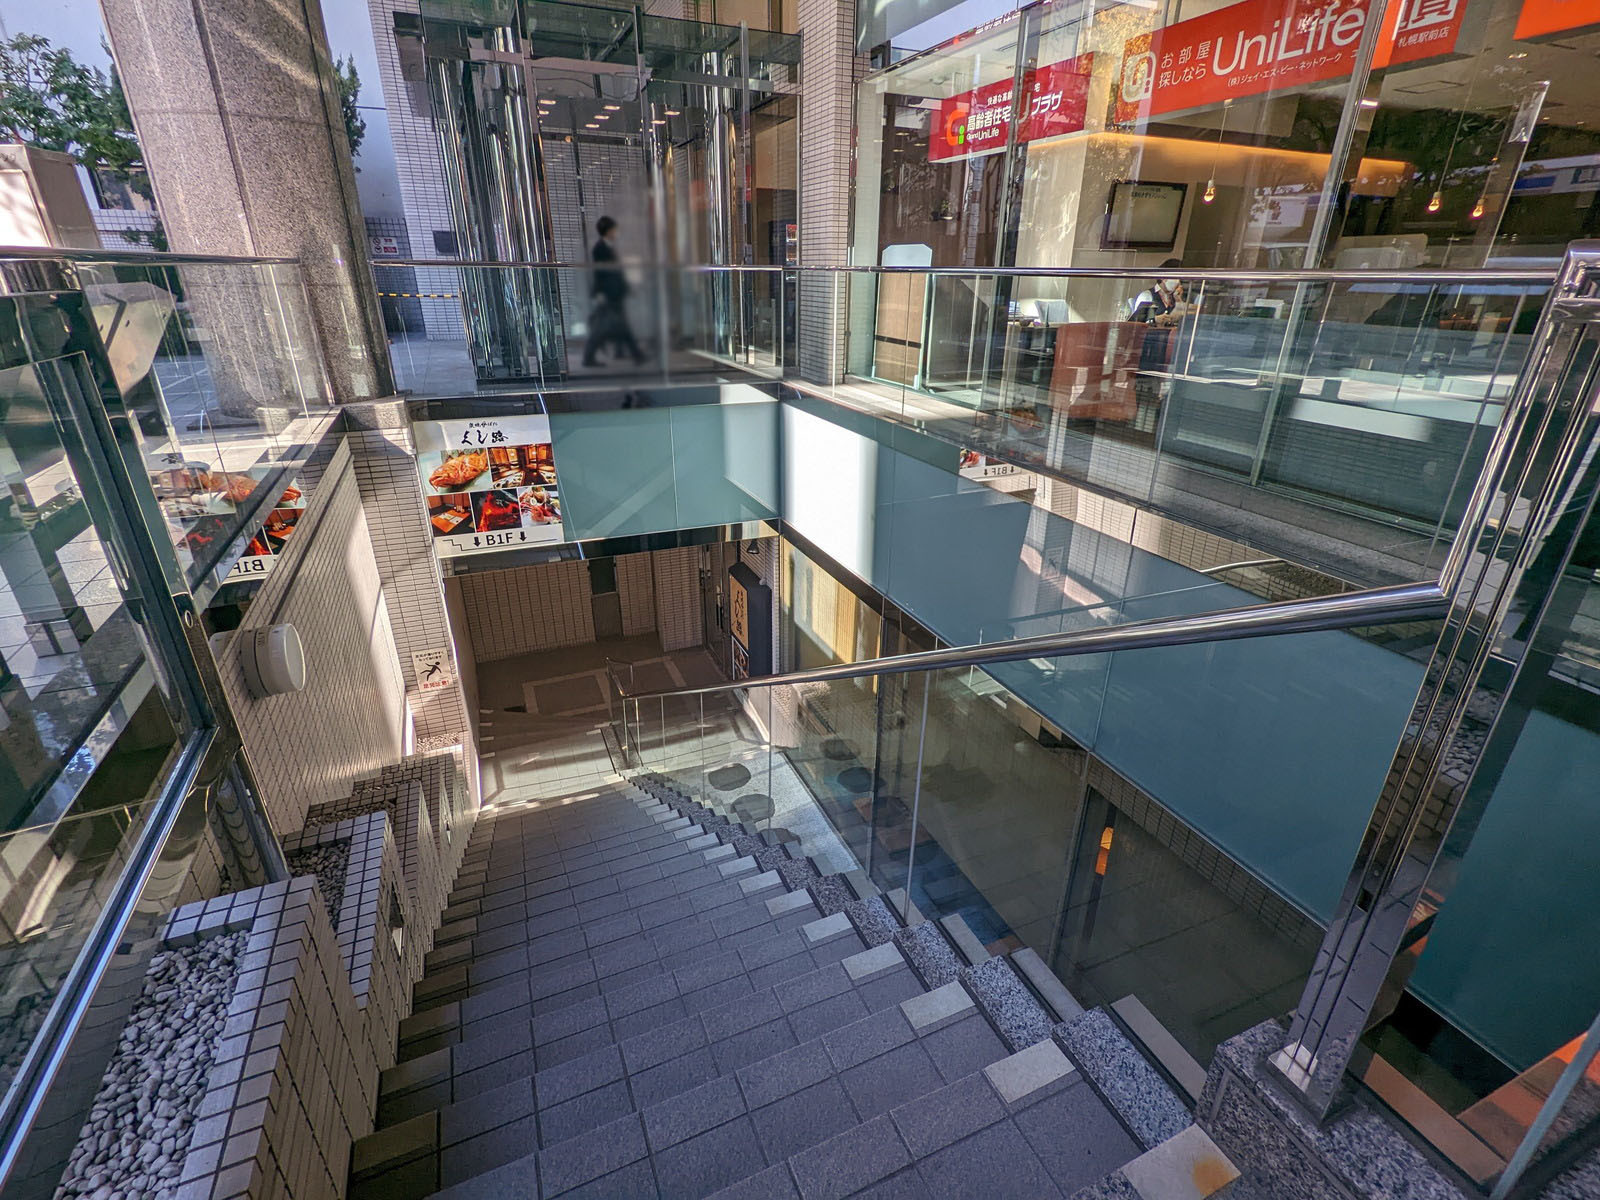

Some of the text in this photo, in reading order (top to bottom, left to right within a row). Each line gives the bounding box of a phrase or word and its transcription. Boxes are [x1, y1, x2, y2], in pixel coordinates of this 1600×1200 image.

[1212, 1, 1365, 76] UniLife
[1158, 63, 1207, 89] 探しなら
[978, 127, 1000, 141] UniLife
[485, 532, 513, 546] B1F
